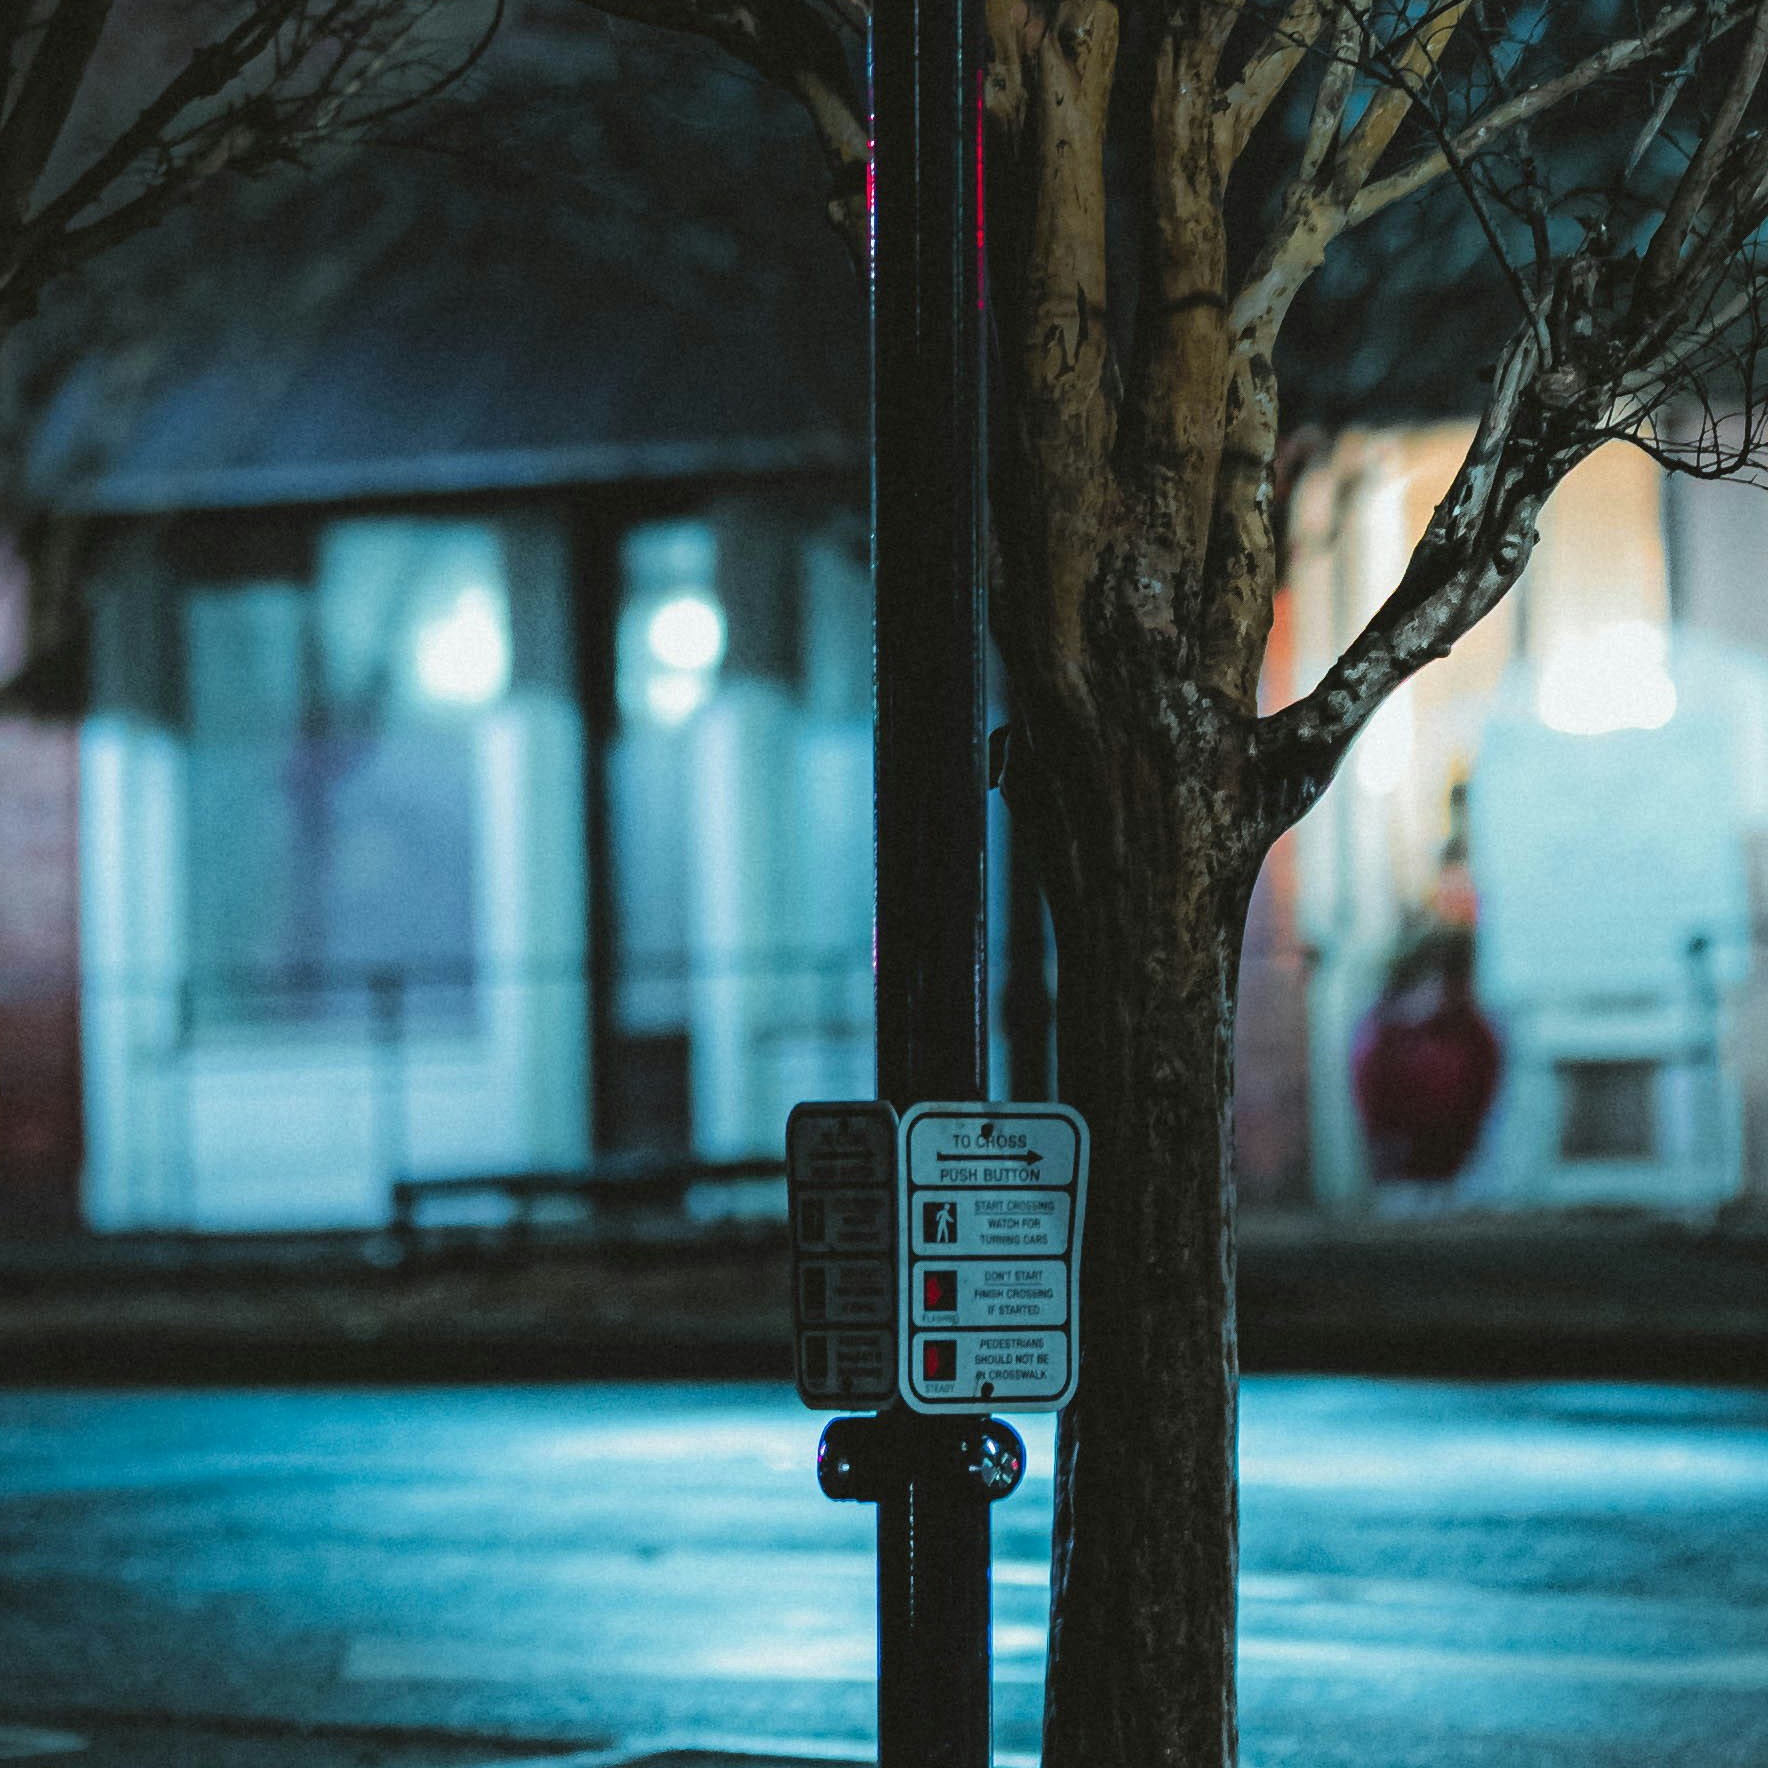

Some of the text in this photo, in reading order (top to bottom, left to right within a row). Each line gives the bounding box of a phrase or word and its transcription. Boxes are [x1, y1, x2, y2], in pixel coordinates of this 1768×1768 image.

[953, 1135, 1027, 1149] TO CROSS
[940, 1168, 1040, 1182] PUSH BUTTON
[975, 1200, 1055, 1212] START CROSSING
[988, 1218, 1040, 1229] WATCH FOR
[980, 1234, 1048, 1245] TURNING CARS
[984, 1270, 1043, 1281] DON'T START
[974, 1288, 1053, 1299] FINISH CROSSING
[988, 1304, 1040, 1315] IF STARTED
[980, 1338, 1044, 1349] PEDESTRIANS
[975, 1354, 1048, 1365] SHOULD NOT BE
[989, 1369, 1047, 1380] CROSSWALK
